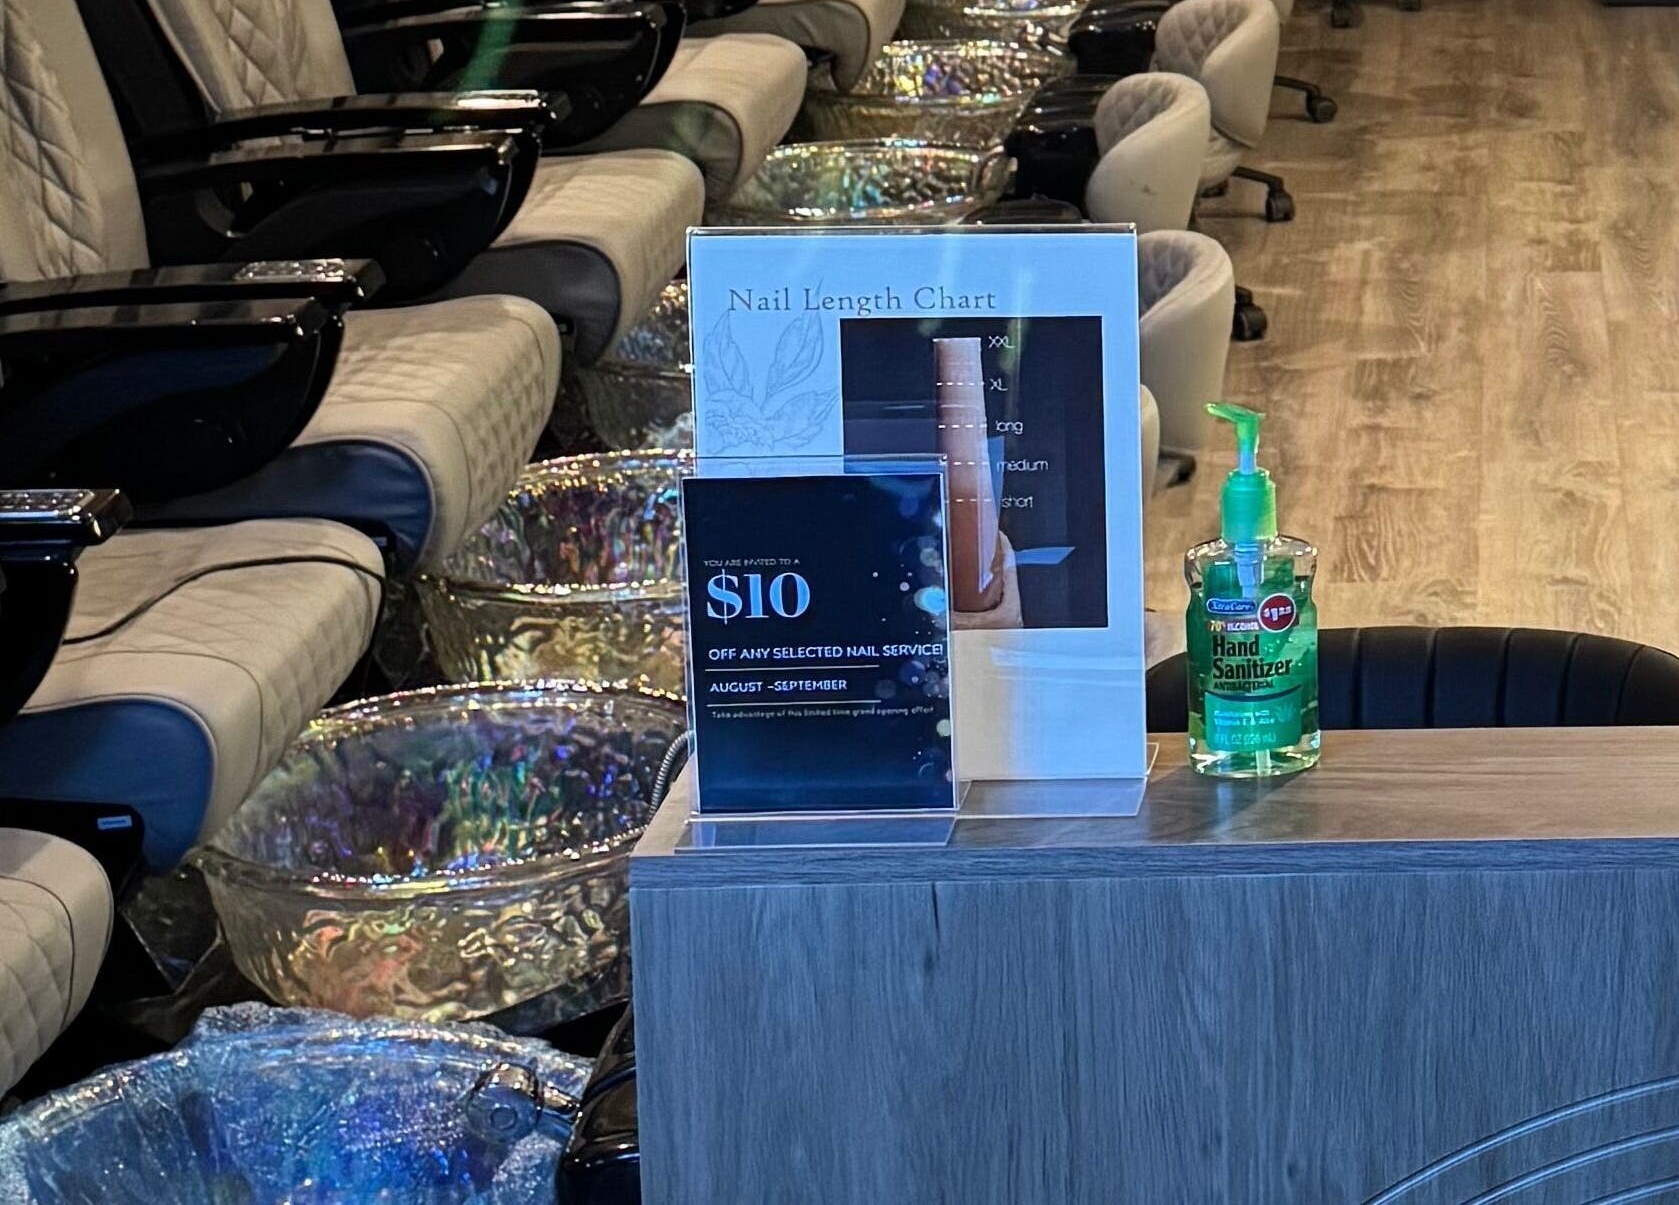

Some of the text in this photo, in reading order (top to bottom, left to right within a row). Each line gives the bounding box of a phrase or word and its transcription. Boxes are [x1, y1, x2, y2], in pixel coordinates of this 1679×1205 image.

[729, 286, 997, 316] Nail Length Chart
[988, 335, 1014, 348] XXL
[989, 378, 1008, 391] XL
[997, 459, 1048, 472] medium
[1001, 496, 1033, 508] short
[703, 559, 723, 567] YOU
[707, 569, 811, 625] $10
[1213, 634, 1260, 657] Hand
[708, 648, 736, 661] OFF
[740, 648, 770, 660] ANY
[773, 646, 843, 659] SELECTED
[846, 645, 880, 657] NAIL
[1213, 657, 1293, 680] Sanitizer
[710, 681, 763, 693] AUGUST
